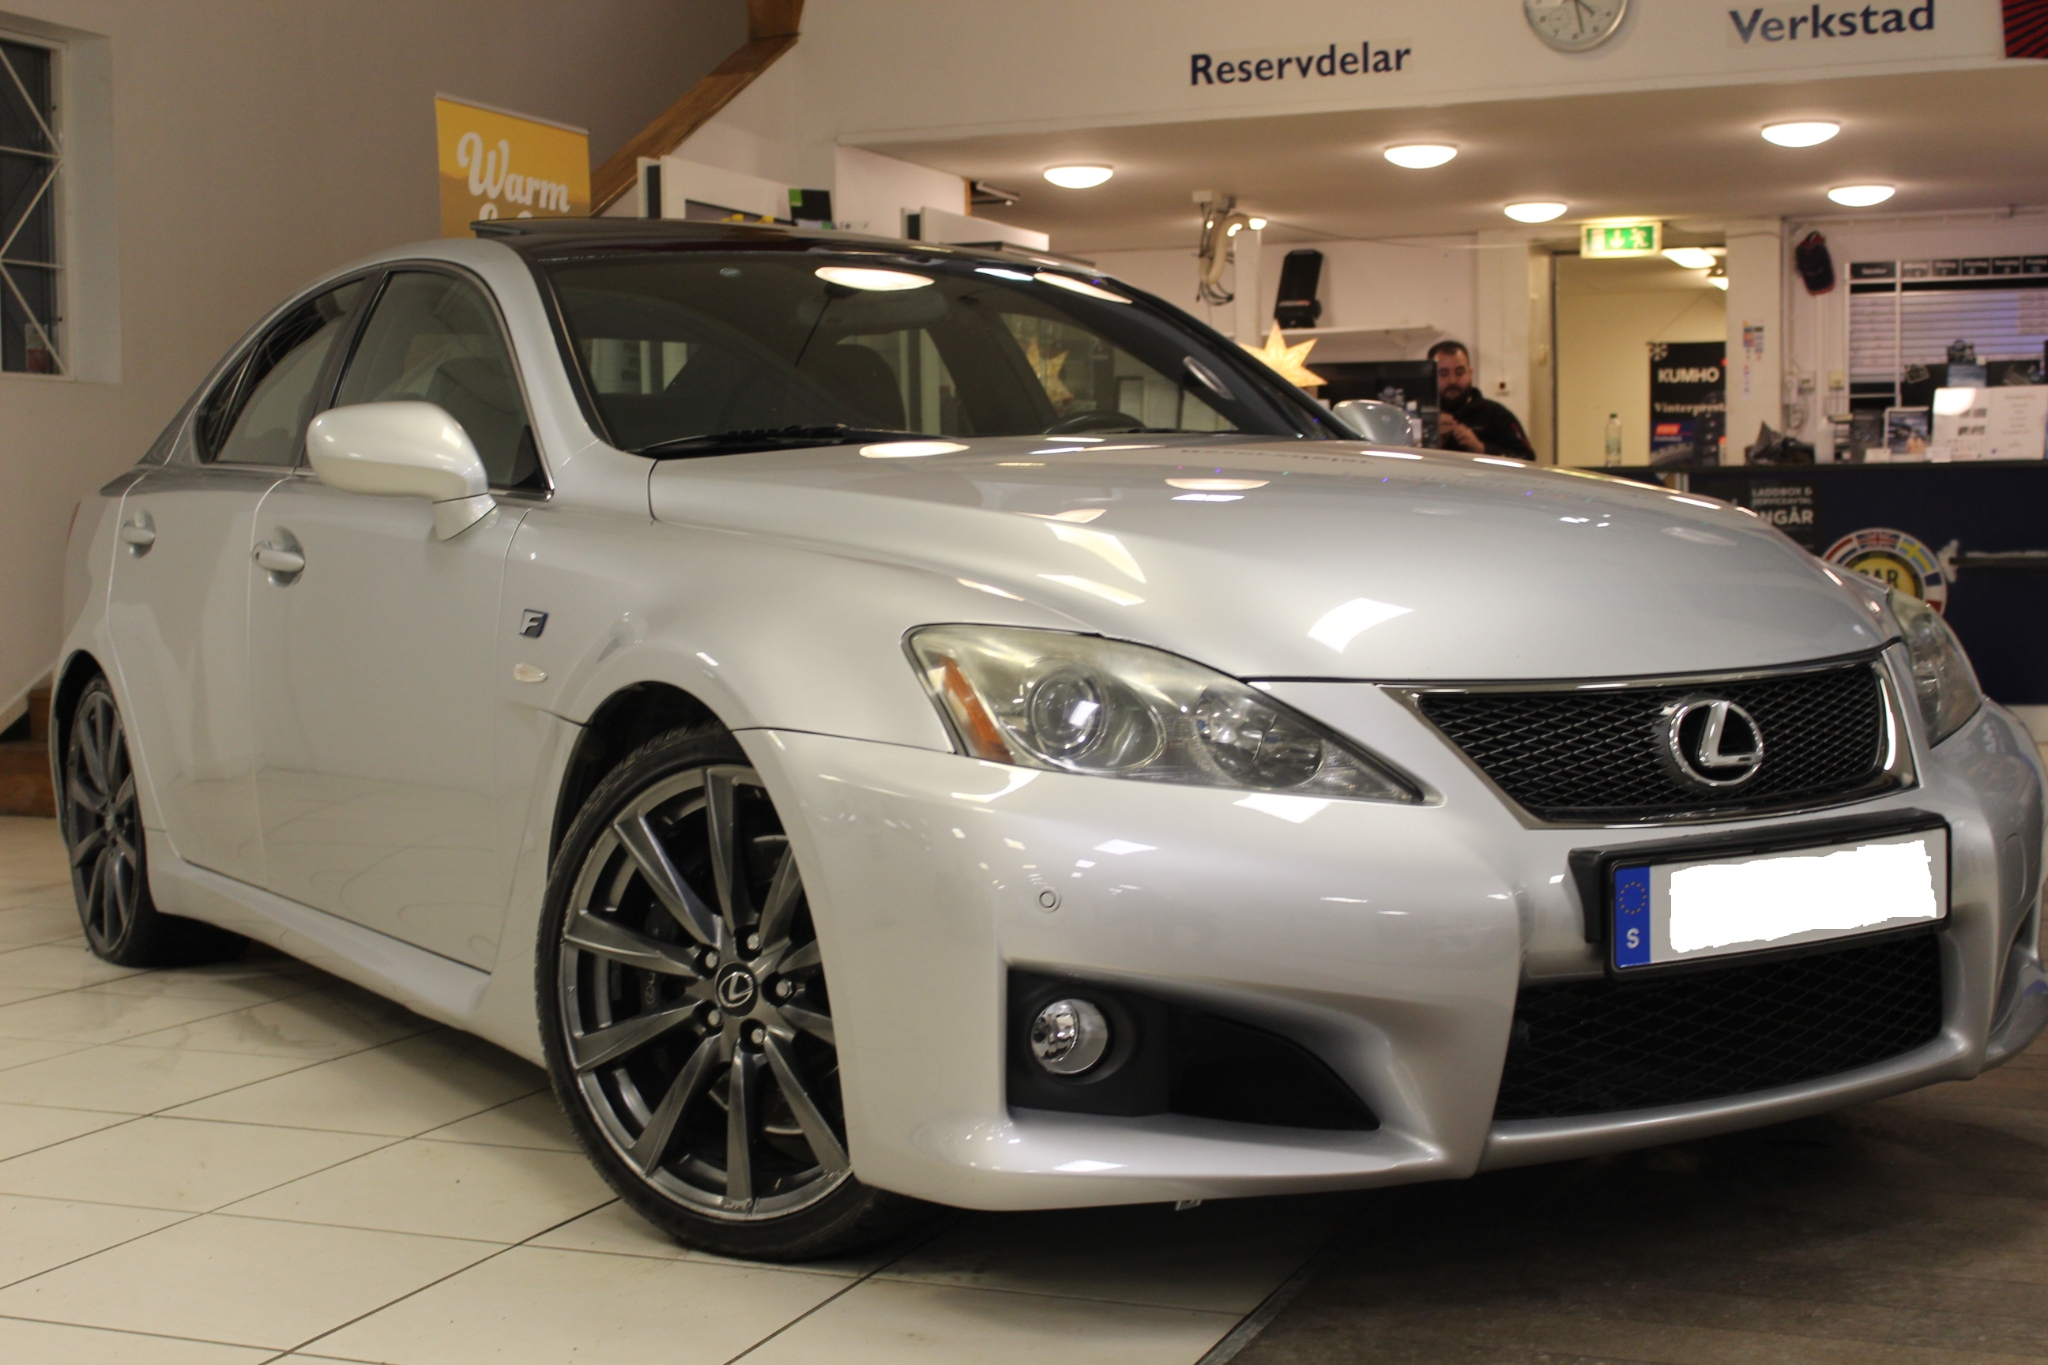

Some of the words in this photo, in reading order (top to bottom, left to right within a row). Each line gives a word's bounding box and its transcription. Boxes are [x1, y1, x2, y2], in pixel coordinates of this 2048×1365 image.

[1729, 0, 1935, 44] Verkstad
[1191, 41, 1412, 86] Reservdelar
[456, 131, 571, 213] Warm
[1657, 366, 1720, 384] KUMHO
[1756, 505, 1815, 526] NGÅR
[1626, 927, 1640, 949] S
